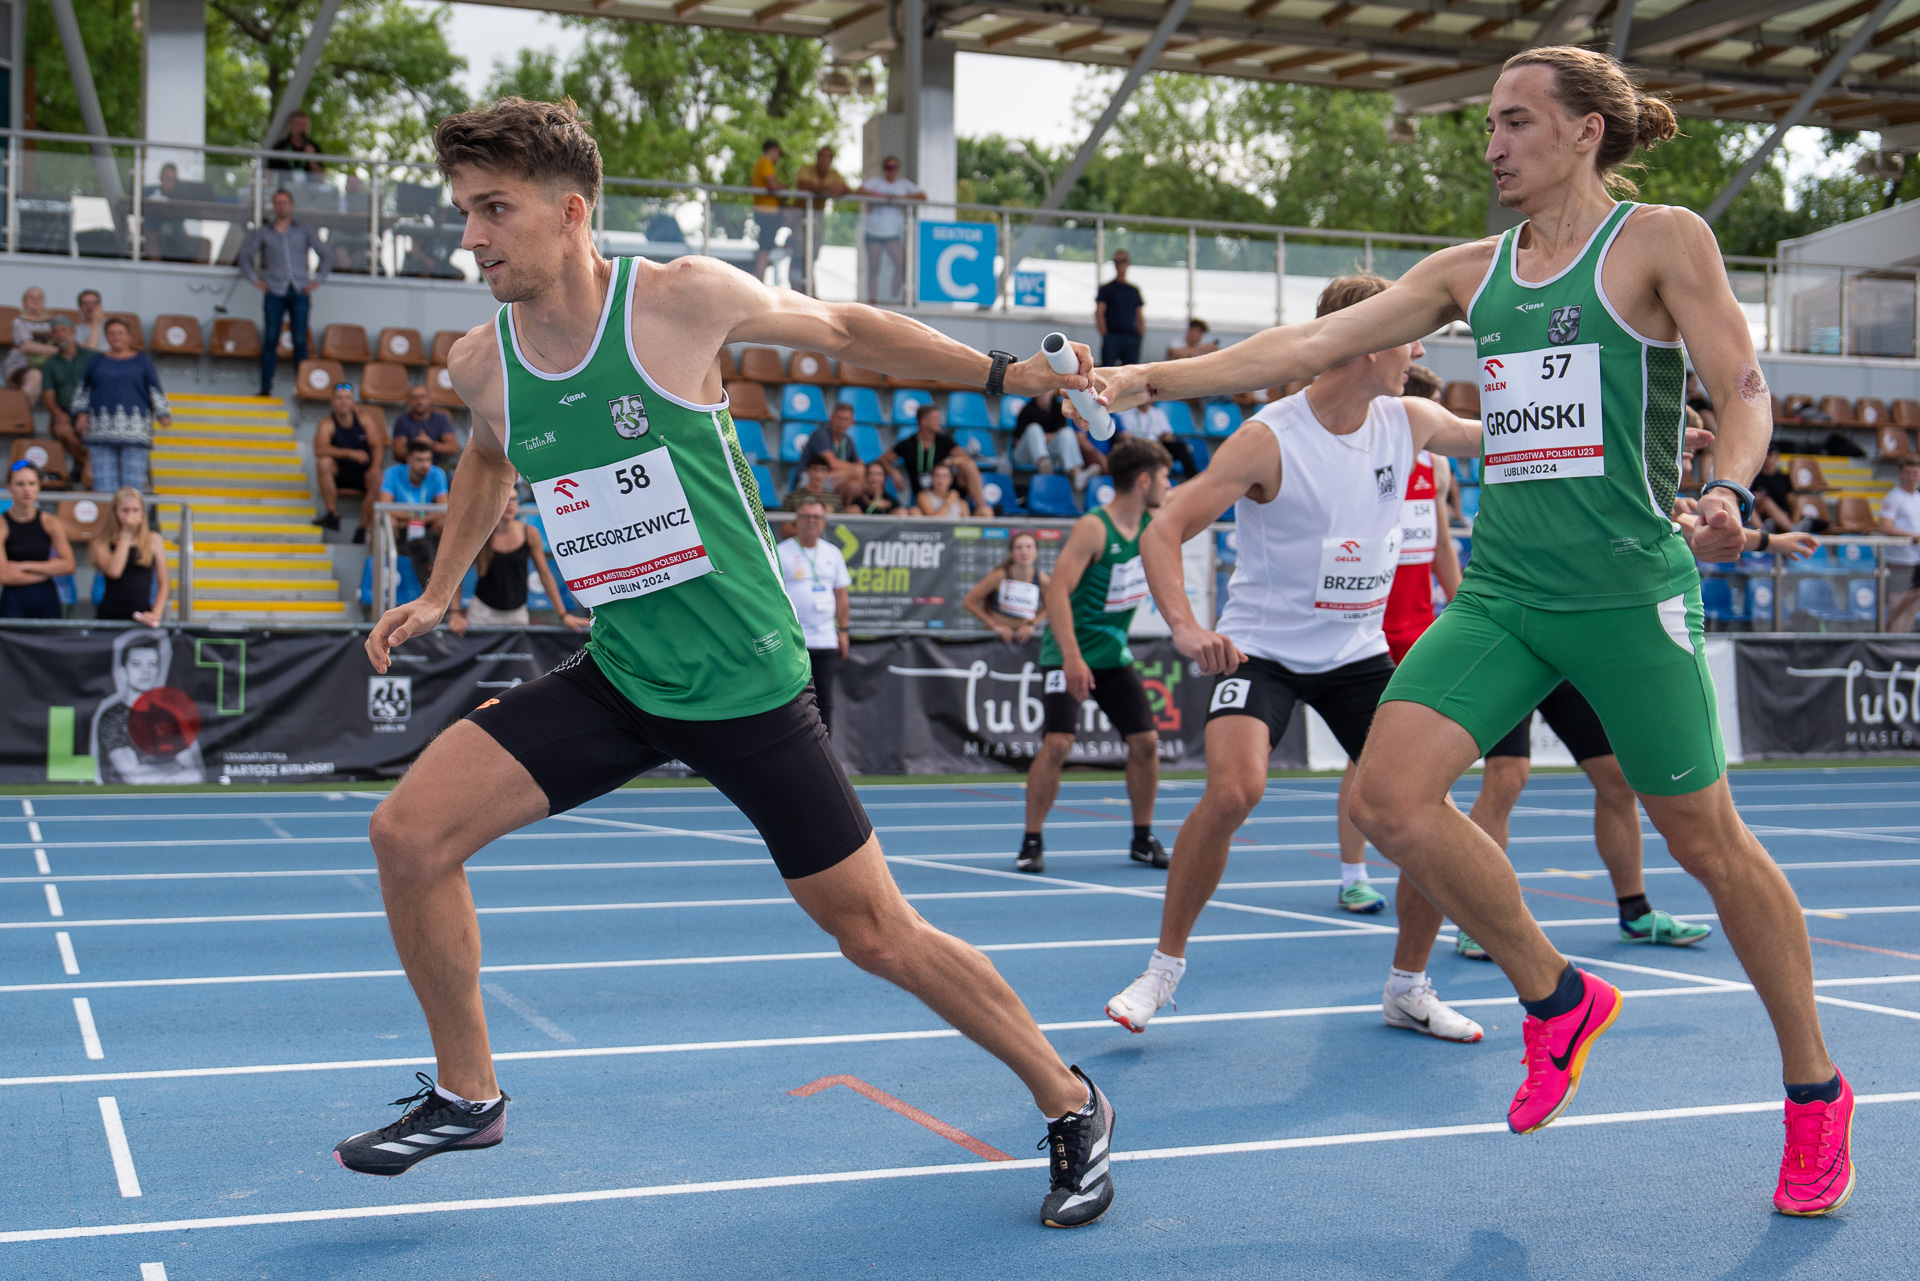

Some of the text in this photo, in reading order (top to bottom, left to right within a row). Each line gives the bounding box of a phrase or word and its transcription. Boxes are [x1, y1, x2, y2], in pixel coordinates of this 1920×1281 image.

[932, 226, 983, 242] SEKTOR
[935, 243, 980, 300] C
[1016, 275, 1046, 294] WC
[1480, 332, 1501, 346] UMCS
[1541, 353, 1572, 380] 57
[1484, 381, 1507, 393] ORLEN
[1486, 401, 1586, 436] GROŃSKI
[1502, 451, 1545, 462] MISTRZOSTWA
[1546, 449, 1576, 459] POLSKI
[1577, 447, 1595, 456] U23
[1503, 463, 1558, 477] LUBLIN 2024
[615, 464, 651, 495] 58
[556, 499, 591, 516] ORLEN
[556, 507, 690, 558] GRZEGORZEWICZ
[899, 531, 942, 541] PERFECT
[862, 541, 946, 570] runner
[583, 576, 603, 587] PZLA
[603, 563, 655, 582] MISTRZOSTWA
[654, 554, 682, 569] POLSKI
[682, 549, 699, 561] U23
[609, 571, 671, 595] LUBLIN 2024
[1343, 609, 1369, 619] LUBLIN
[1049, 673, 1060, 688] 4
[1219, 681, 1240, 705] 6
[1844, 730, 1914, 747] MIASTO
[222, 764, 279, 777] BARTOSZ
